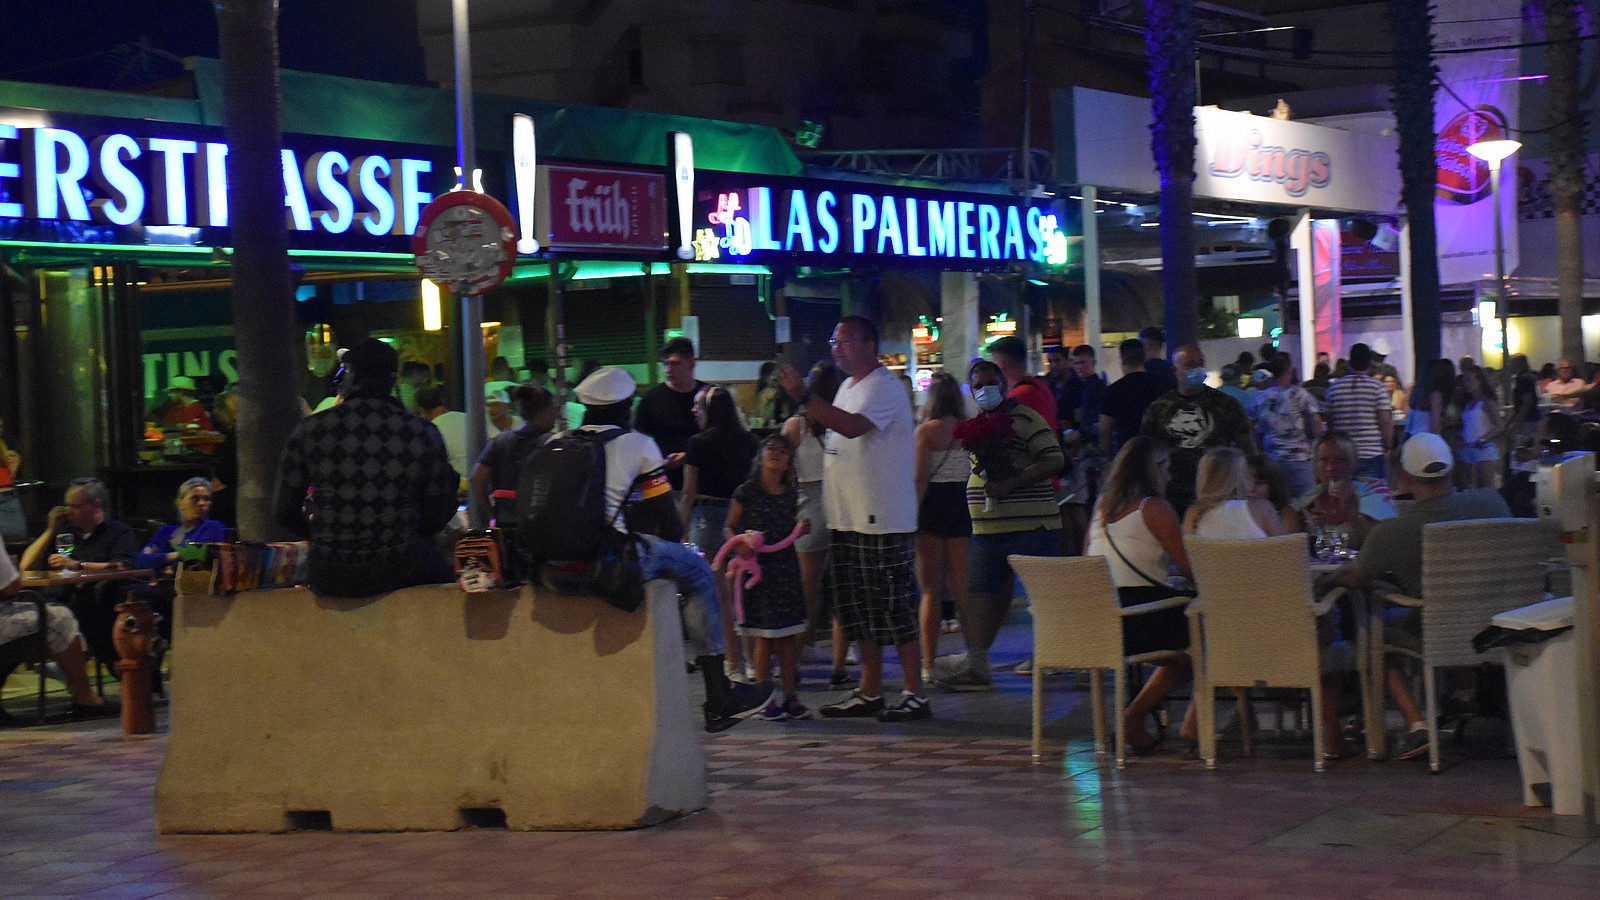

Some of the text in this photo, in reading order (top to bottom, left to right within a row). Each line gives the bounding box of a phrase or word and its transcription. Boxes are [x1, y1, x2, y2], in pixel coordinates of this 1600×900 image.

[1207, 128, 1331, 197] Dings
[756, 186, 1044, 263] LAS PALMERAS
